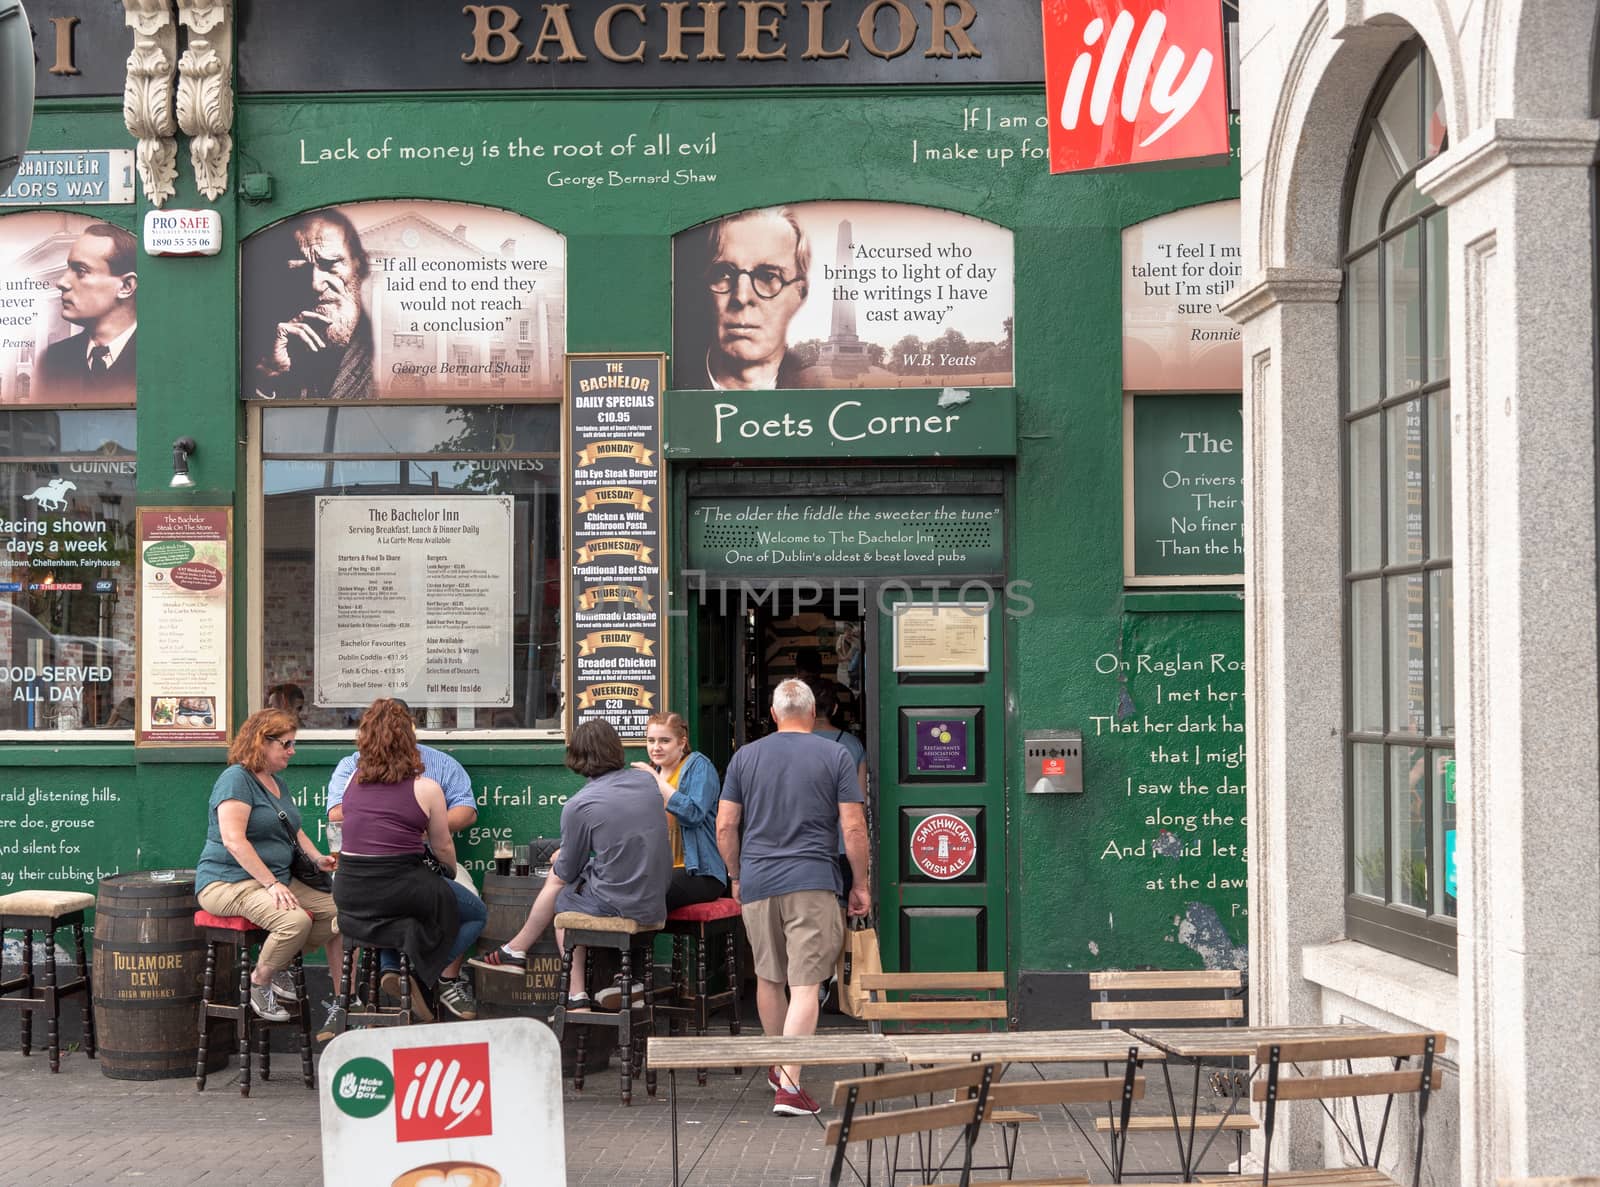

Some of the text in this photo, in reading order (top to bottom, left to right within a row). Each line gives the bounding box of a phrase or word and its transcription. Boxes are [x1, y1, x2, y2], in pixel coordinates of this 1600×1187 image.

[461, 1, 982, 63] BACHELOR
[1060, 9, 1213, 148] illy
[299, 132, 717, 166] Lack of money is the root of all evil
[547, 169, 717, 189] George Bernard Shaw
[66, 181, 105, 196] WAY
[152, 217, 210, 229] PRO SAFE
[152, 238, 210, 247] 1890 55 55 06
[848, 243, 972, 259] “Accursed who
[375, 256, 548, 272] “If all economists were
[1132, 261, 1205, 277] talent for
[824, 263, 997, 283] brings to light of day
[1191, 328, 1241, 341] Ronnie
[2, 338, 36, 348] Pearse
[902, 354, 976, 366] W.B. Yeats
[392, 362, 531, 377] George Bernard Shaw
[606, 363, 623, 373] THE
[579, 376, 650, 392] BACHELOR
[576, 395, 655, 408] DAILY SPECIALS
[597, 411, 630, 423] €10.95
[713, 401, 960, 444] Poets Corner
[597, 444, 634, 454] MONDAY
[575, 468, 658, 480] Rib Eye Steak Burger
[595, 490, 634, 500] TUESDAY
[368, 508, 459, 521] The Bachelor Inn
[587, 512, 644, 521] Chicken Wild
[694, 504, 1000, 524] “The older the fiddle the sweeter the tune”
[52, 517, 106, 532] shown
[349, 525, 374, 536] Serving
[412, 525, 431, 535] Lunch
[439, 525, 461, 535] Dinner
[463, 525, 480, 536] Daily
[584, 521, 648, 530] Mushroom Pasta
[1171, 515, 1238, 534] No finer
[757, 529, 934, 546] Welcome to The Bachelor Inn
[6, 537, 108, 555] days a week
[588, 541, 641, 552] WEDNESDAY
[32, 558, 78, 568] Cheltenham,
[80, 558, 120, 568] Fairyhouse
[725, 549, 966, 566] One of Dublin's oldest best loved pubs
[573, 565, 659, 575] Traditional Beef Stew
[575, 612, 621, 621] Homemade
[601, 634, 631, 643] FRIDAY
[577, 658, 657, 668] Breaded Chicken
[1095, 653, 1204, 677] On Raglan
[42, 666, 112, 682] SERVED
[13, 686, 84, 701] ALL DAY
[426, 684, 482, 693] Full Menu Inside
[591, 687, 639, 697] WEEKENDS
[606, 699, 623, 709] €20
[1089, 715, 1217, 736] That her dark
[27, 787, 89, 806] glistening
[495, 786, 568, 806] frail are
[51, 818, 95, 832] grouse
[917, 819, 970, 844] SMITHWICKS
[468, 827, 513, 845] gave
[22, 839, 81, 854] silent fox
[921, 858, 966, 874] IRISH ALE
[19, 866, 94, 884] their cubbing
[113, 951, 183, 971] TULLAMORE
[358, 1085, 378, 1093] May
[360, 1077, 384, 1087] Make
[401, 1058, 486, 1131] illy
